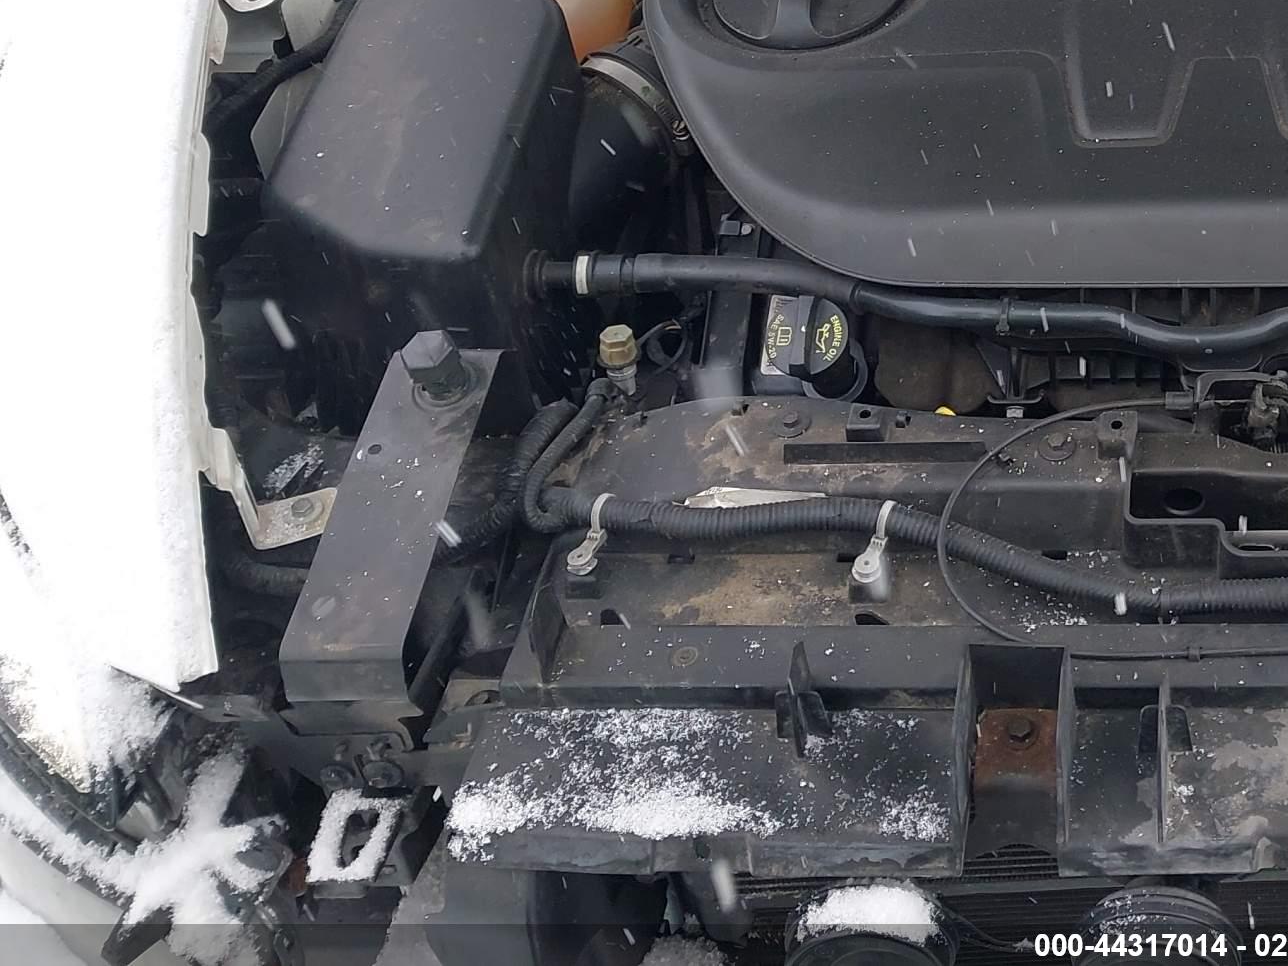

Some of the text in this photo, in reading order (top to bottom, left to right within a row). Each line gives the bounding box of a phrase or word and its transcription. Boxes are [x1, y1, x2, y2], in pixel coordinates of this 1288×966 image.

[770, 314, 785, 330] SAE
[823, 315, 842, 361] ENGINE OIL
